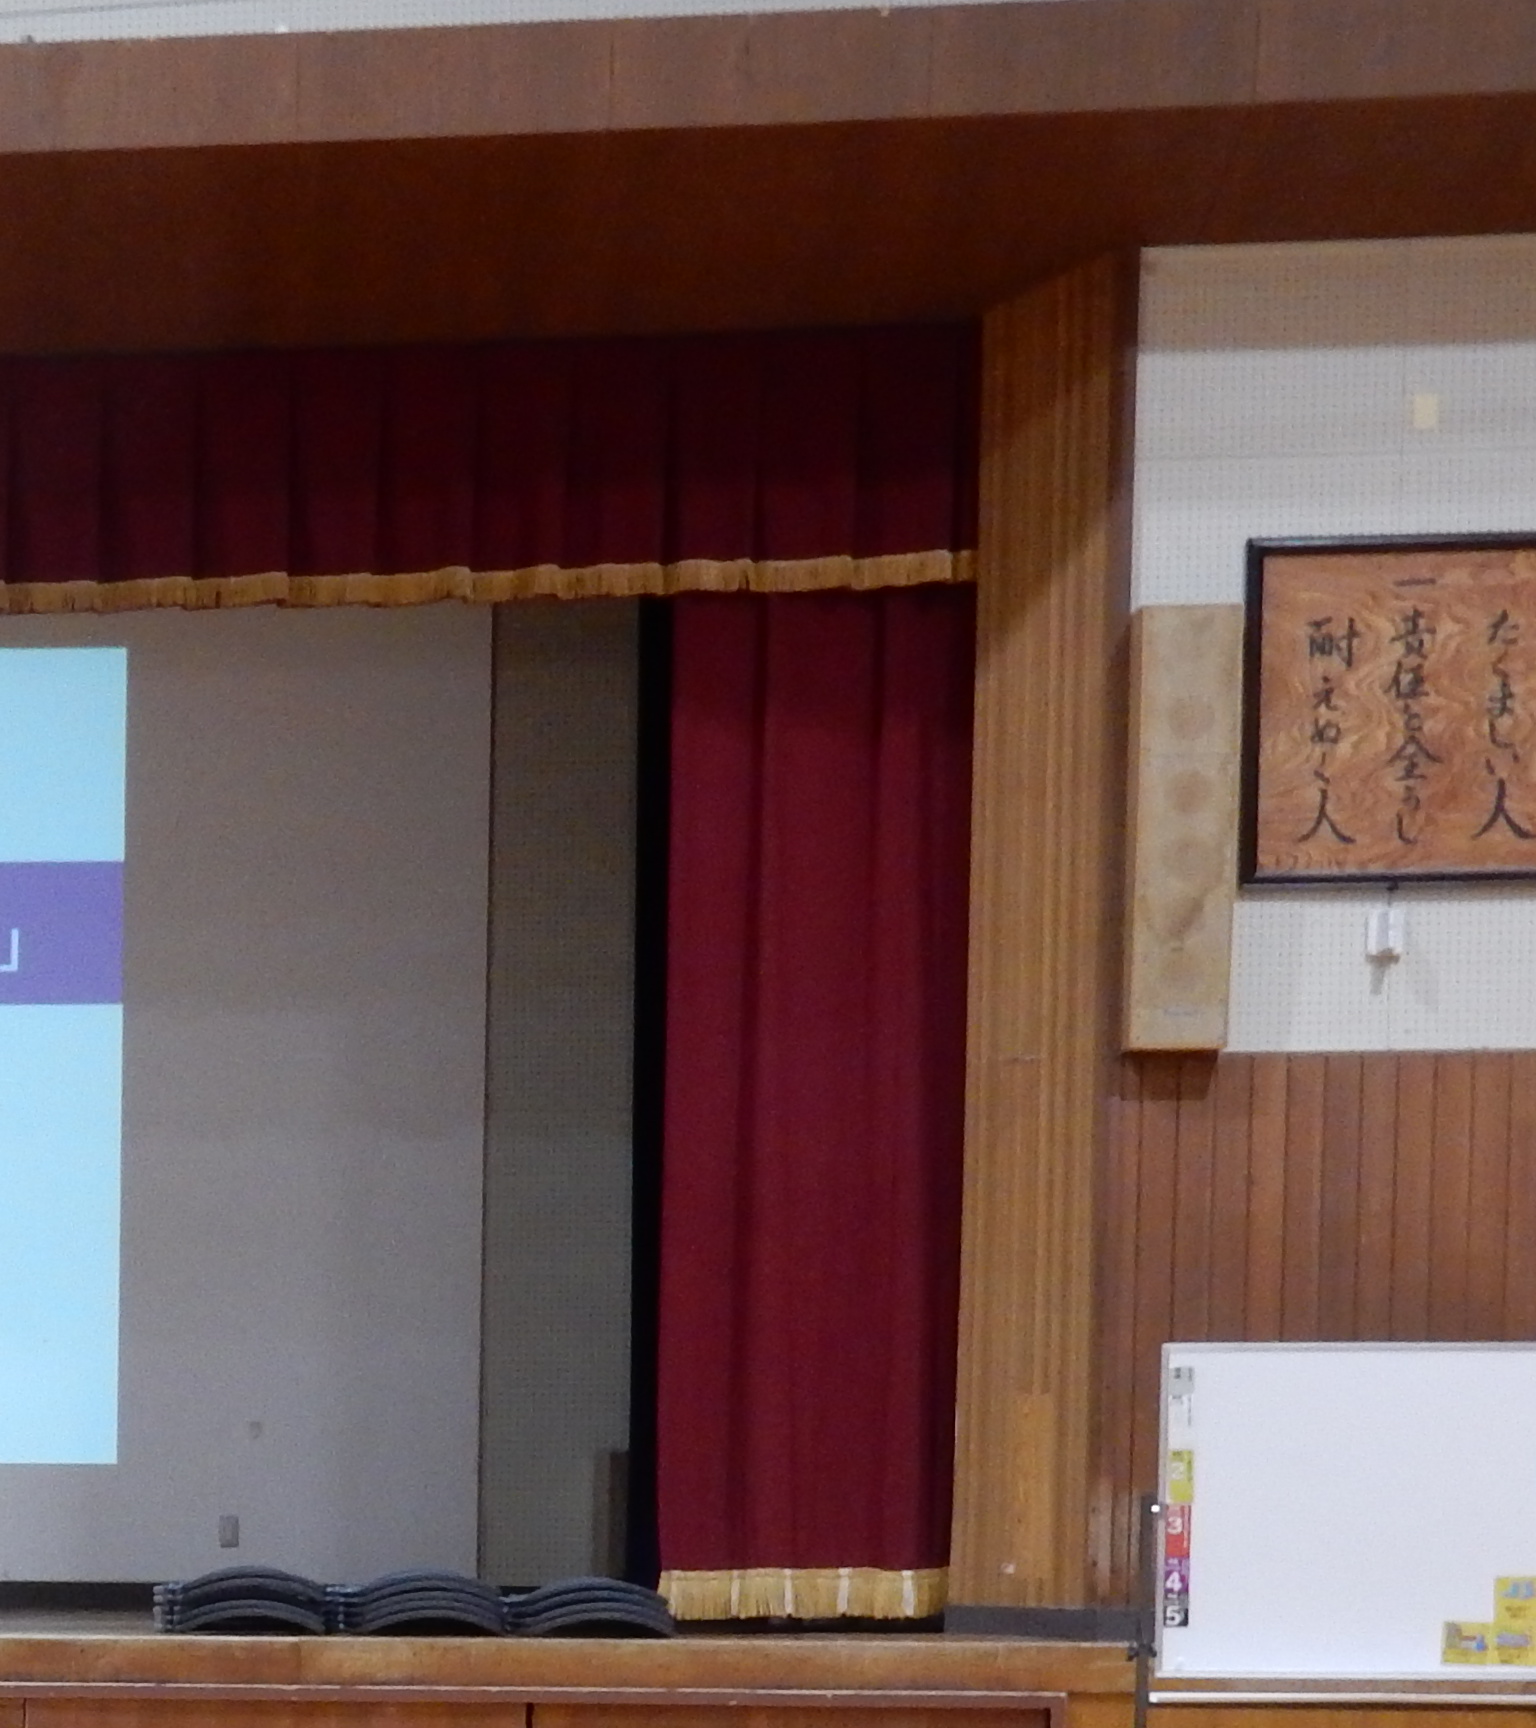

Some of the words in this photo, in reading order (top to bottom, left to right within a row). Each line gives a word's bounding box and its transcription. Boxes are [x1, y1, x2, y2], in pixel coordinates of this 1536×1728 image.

[1167, 1516, 1183, 1535] 3
[1165, 1570, 1183, 1593] 4
[1165, 1605, 1182, 1627] 5
